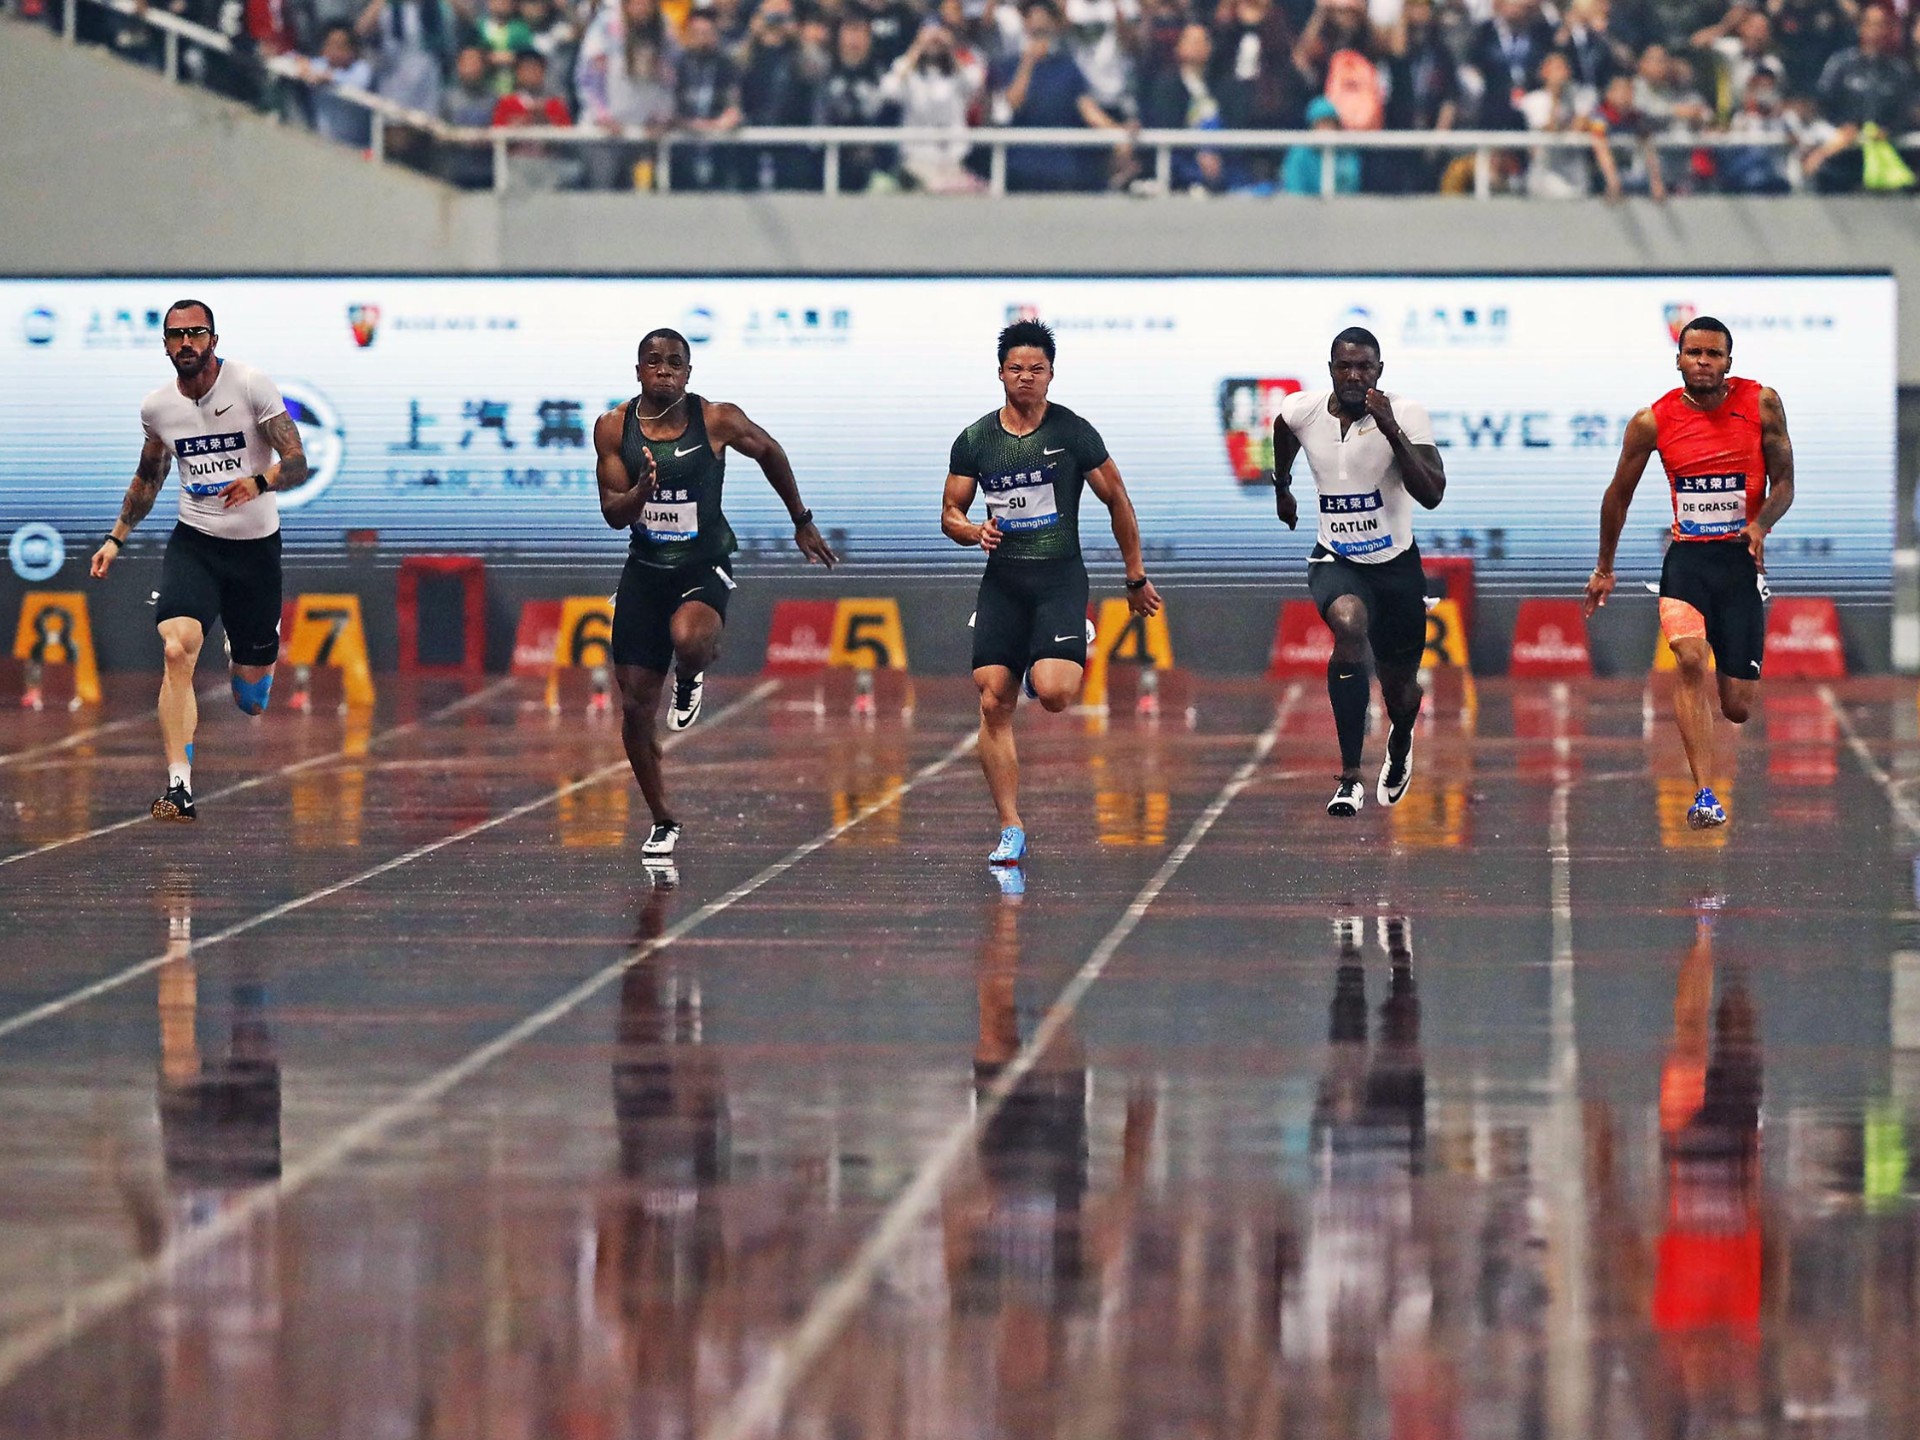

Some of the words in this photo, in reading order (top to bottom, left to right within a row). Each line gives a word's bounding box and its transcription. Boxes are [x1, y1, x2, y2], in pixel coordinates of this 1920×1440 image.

[387, 398, 626, 452] 上汽集
[183, 437, 237, 453] 上汽荣威
[189, 457, 241, 475] GULIYEV
[1682, 476, 1737, 489] 上汽荣威
[1008, 497, 1026, 509] SU
[1326, 496, 1376, 510] 上汽荣威
[1683, 502, 1695, 511] DE
[1698, 501, 1738, 512] GRASSE
[644, 509, 678, 523] UJAH
[1010, 516, 1051, 528] Shanghai
[1330, 518, 1377, 533] GATLIN
[1700, 524, 1740, 533] Shanghai
[1346, 538, 1386, 552] Shanghai
[32, 606, 77, 663] 8
[305, 608, 349, 665] 7
[571, 611, 612, 664] 6
[844, 614, 890, 668] 5
[1109, 613, 1156, 662] 4
